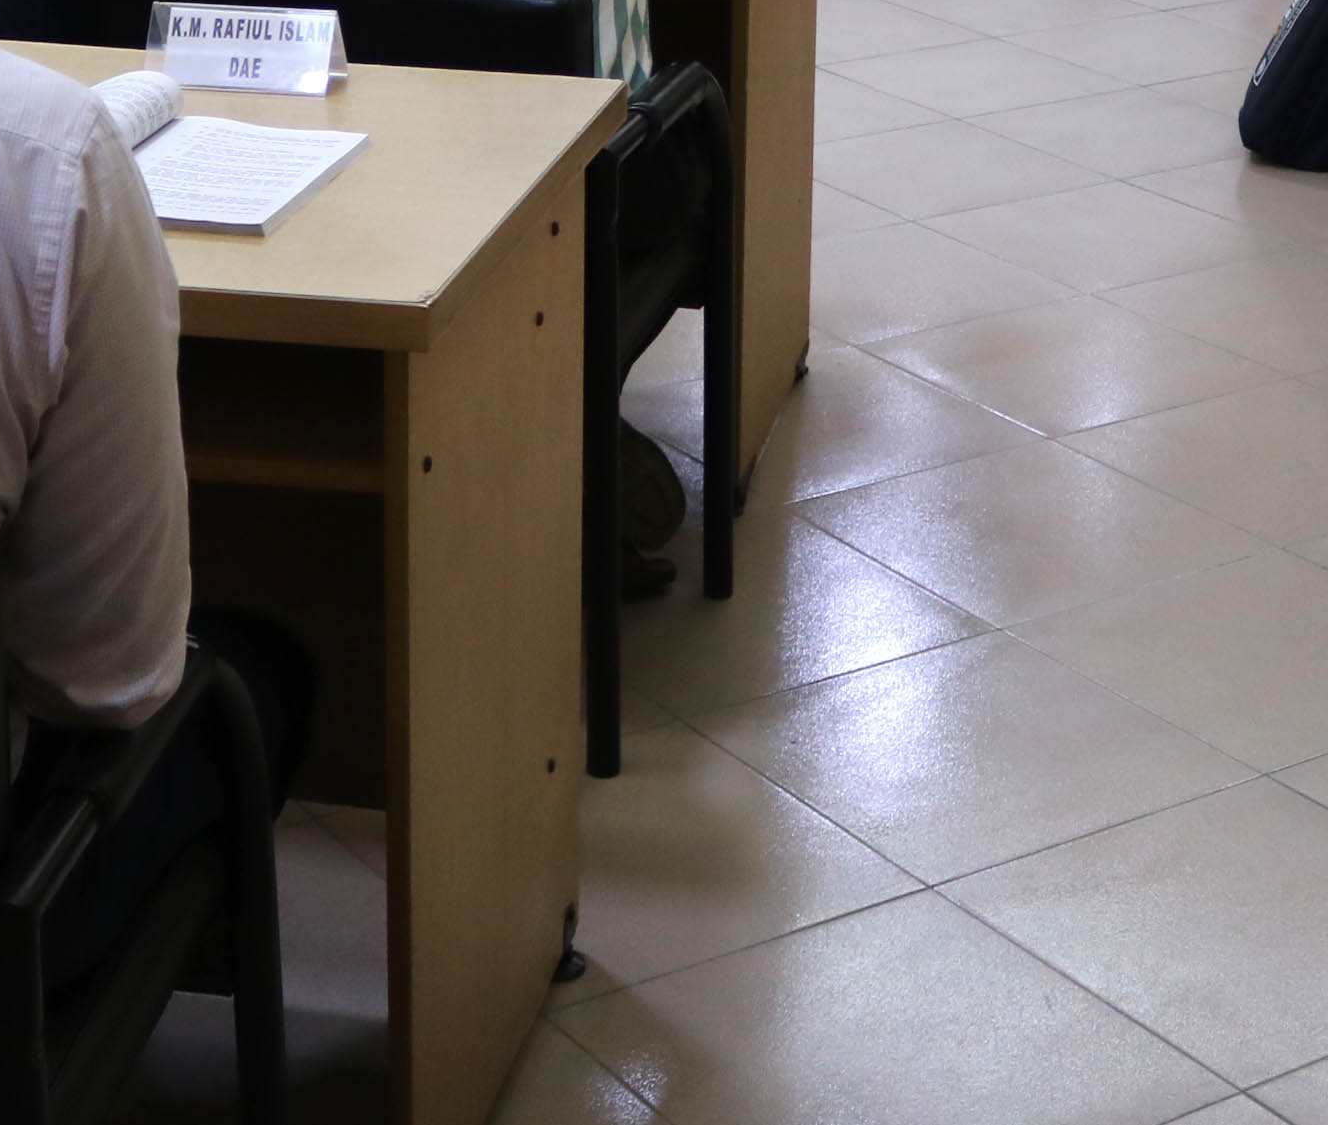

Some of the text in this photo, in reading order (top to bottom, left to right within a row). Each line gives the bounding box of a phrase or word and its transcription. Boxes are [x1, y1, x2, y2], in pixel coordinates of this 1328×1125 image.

[171, 16, 330, 44] K.M. RAFIUL ISLAM
[228, 57, 262, 79] DAE
